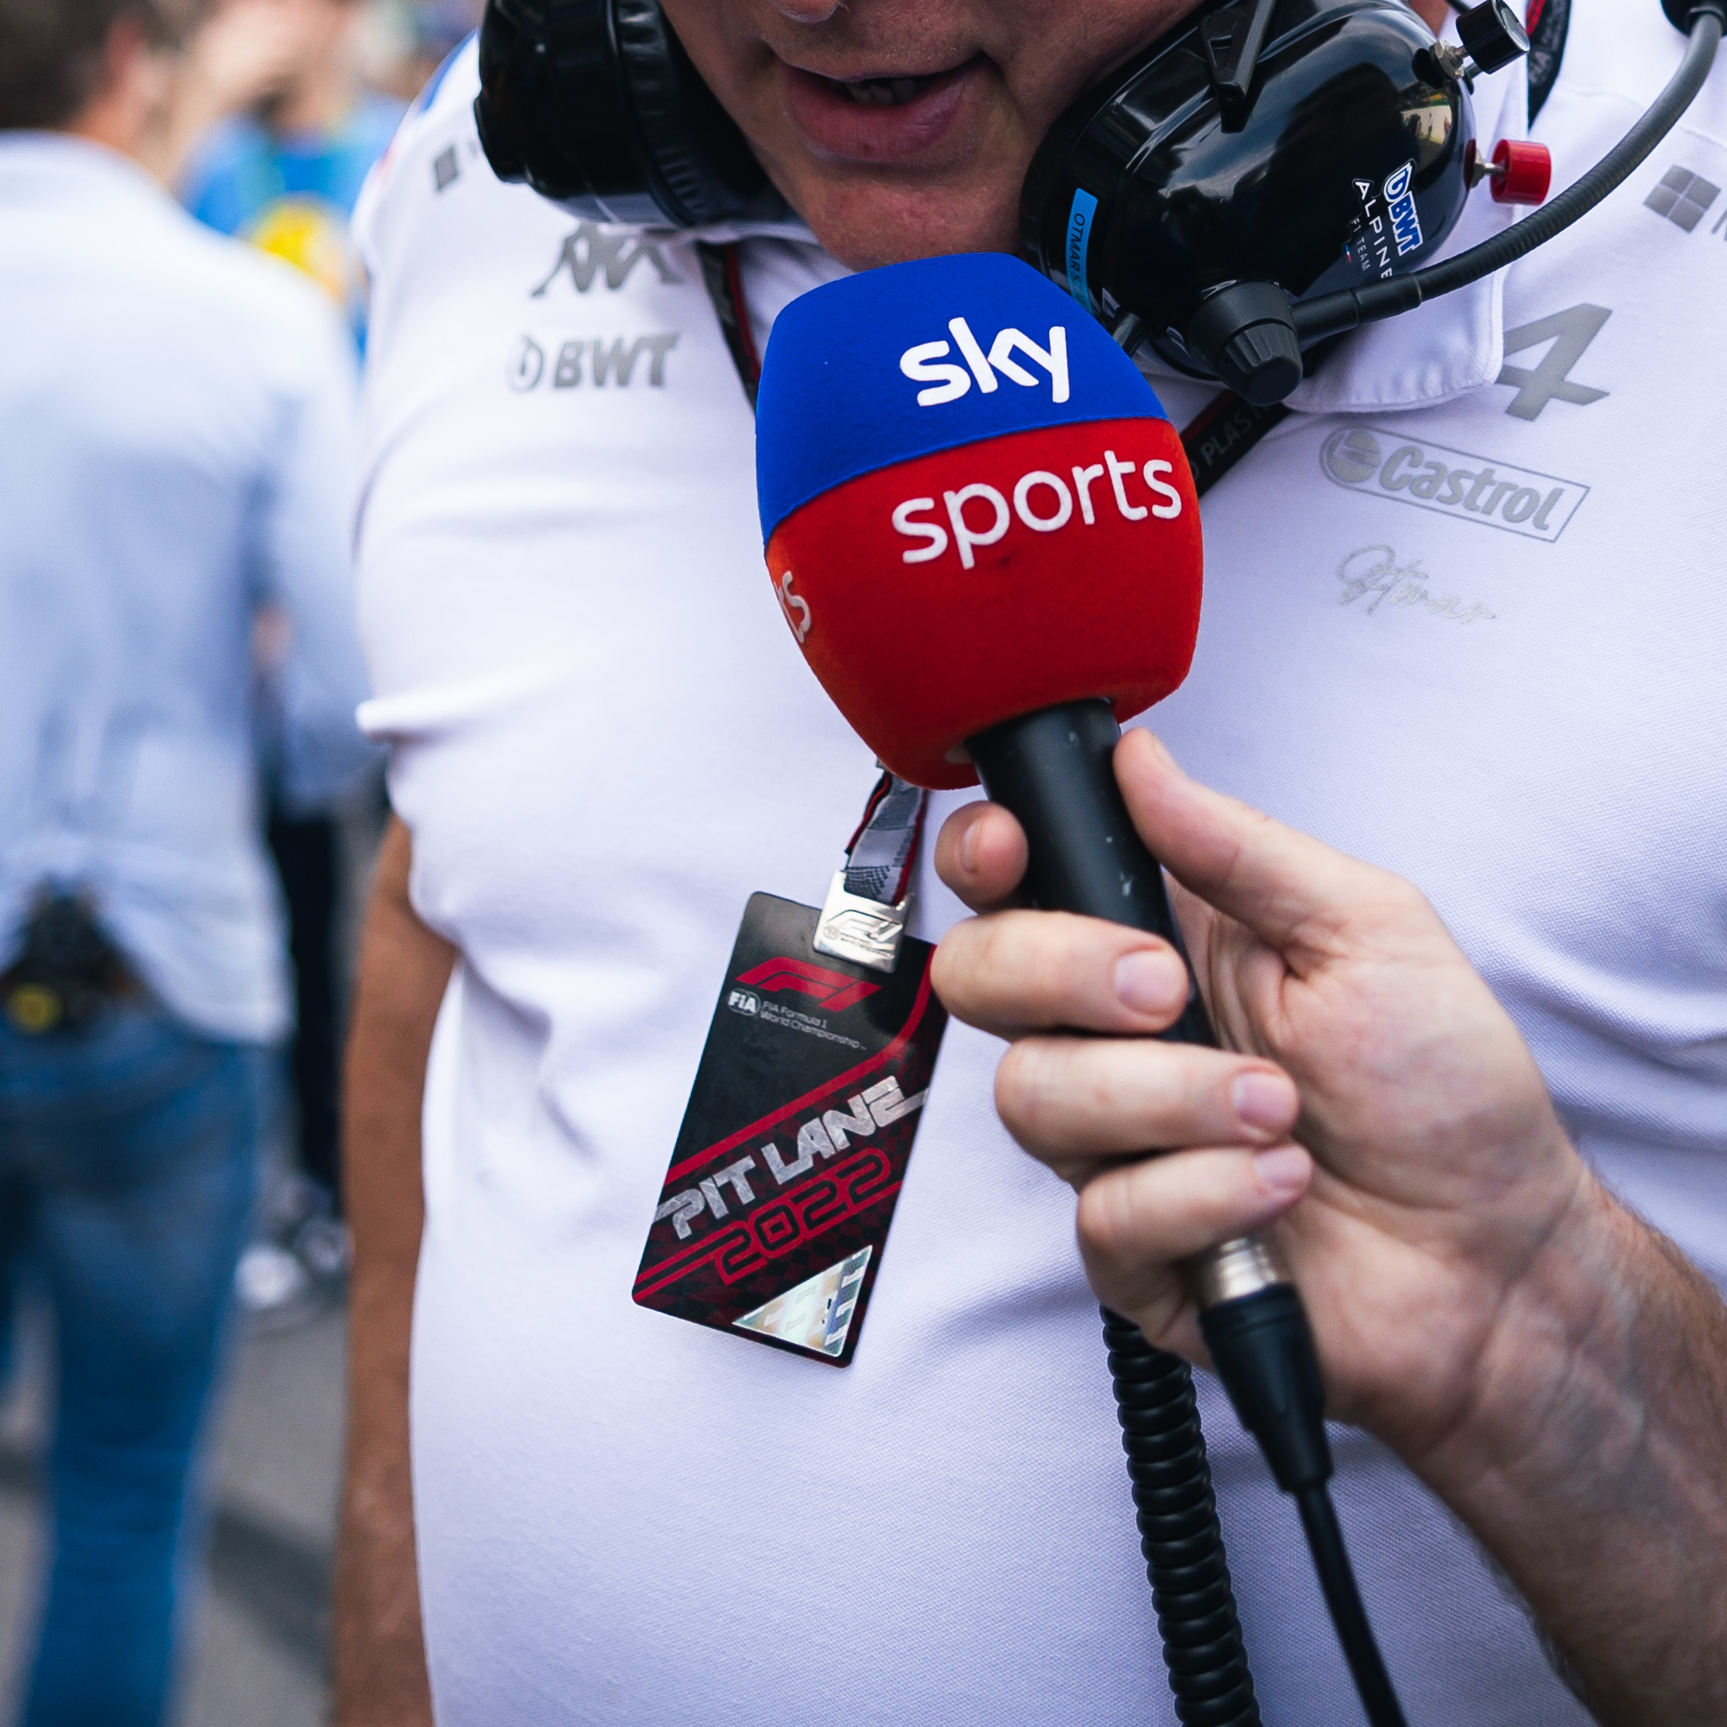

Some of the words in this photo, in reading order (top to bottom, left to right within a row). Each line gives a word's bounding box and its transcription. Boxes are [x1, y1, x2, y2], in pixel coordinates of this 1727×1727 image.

[1069, 212, 1086, 272] OTMAR
[1350, 217, 1362, 233] F1
[1356, 236, 1372, 272] TEAM
[1354, 180, 1393, 279] ALPINE
[1388, 190, 1423, 257] BWT
[553, 332, 681, 390] BWT
[899, 316, 1070, 407] sky
[891, 449, 1183, 571] sports
[1377, 445, 1567, 532] Castrol
[652, 1154, 757, 1240] PIT
[760, 1074, 930, 1186] LANE
[711, 1146, 892, 1286] 2022
